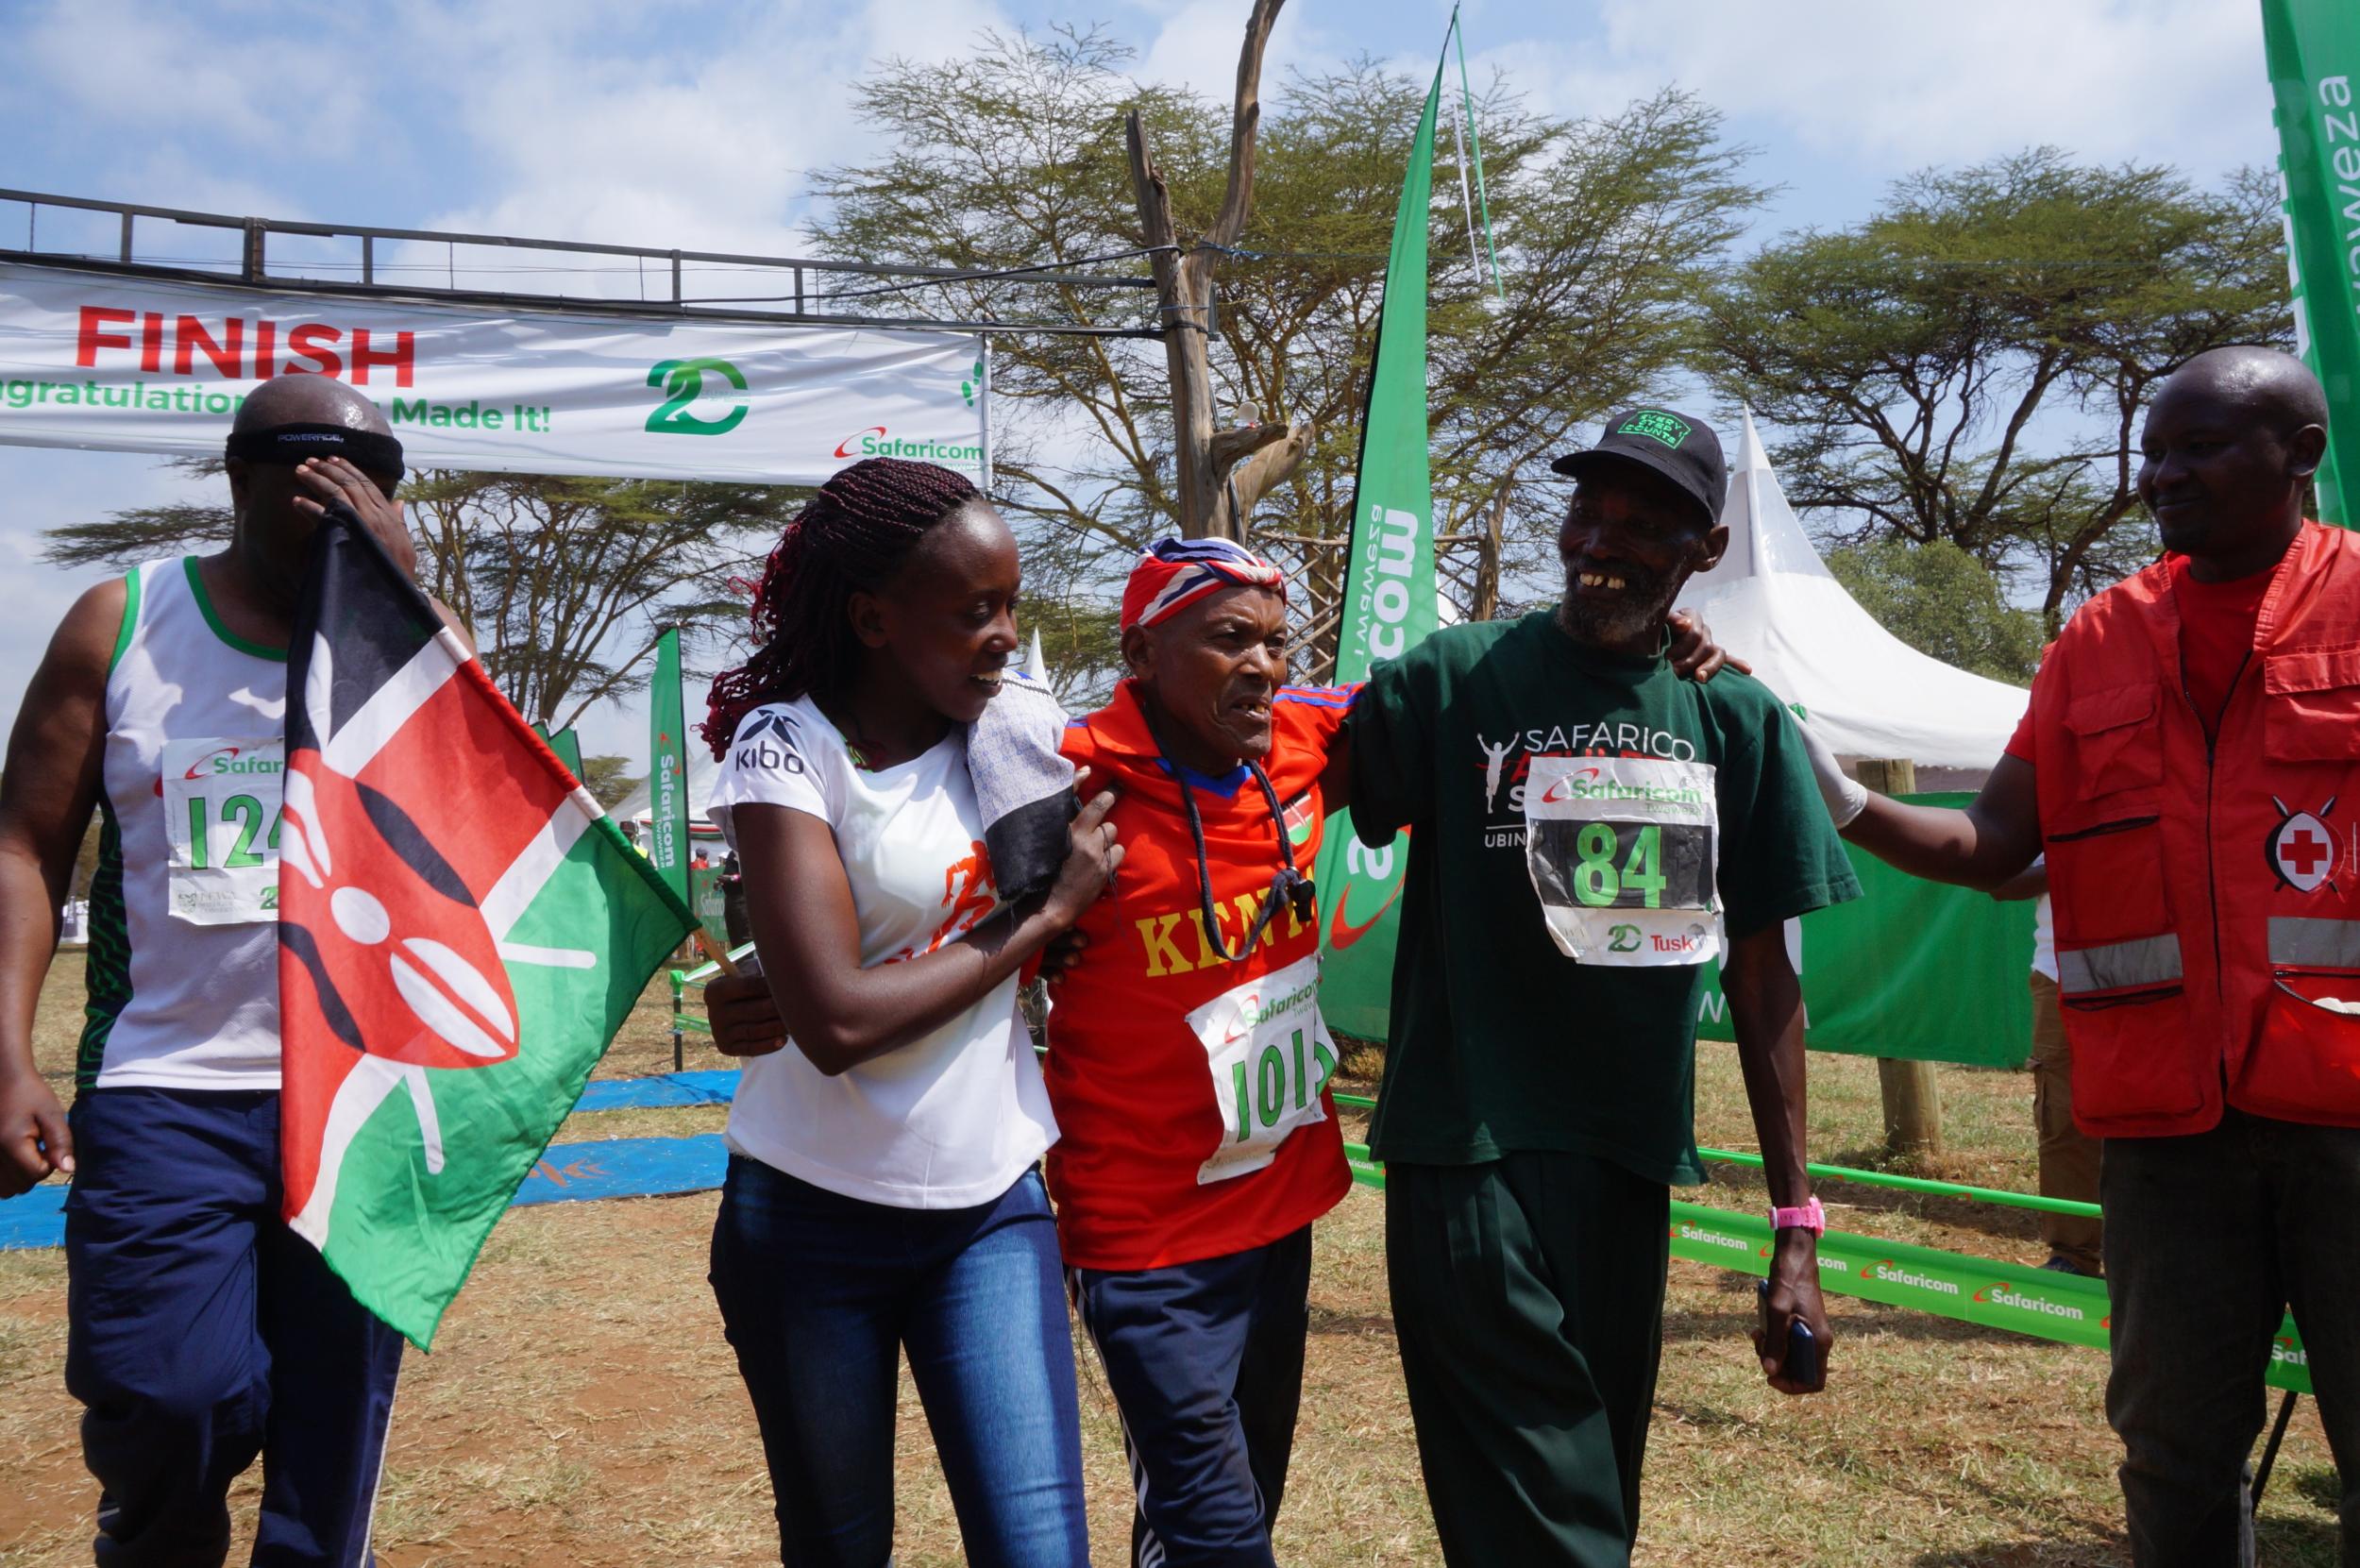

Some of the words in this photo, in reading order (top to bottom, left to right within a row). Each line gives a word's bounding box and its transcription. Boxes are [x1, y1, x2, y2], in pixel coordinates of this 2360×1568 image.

[76, 305, 414, 388] FINISH
[0, 379, 245, 413] gratulatio
[393, 397, 503, 430] Made
[514, 405, 550, 432] It!
[645, 357, 749, 436] 20
[1626, 424, 1676, 444] COUNTS
[1639, 419, 1672, 431] STEP
[862, 436, 984, 460] Safaricom
[1524, 721, 1695, 763] SAFARICO
[213, 756, 283, 774] Safar
[1571, 779, 1702, 803] Safaricom
[661, 754, 675, 867] Safaricom
[1484, 833, 1526, 849] UBIN
[1574, 822, 1666, 908] 84
[1650, 935, 1694, 952] Tusk
[1681, 1224, 1747, 1251] Safaricom
[1877, 1265, 1959, 1294] Safaricom
[1991, 1289, 2083, 1320] Safaricom
